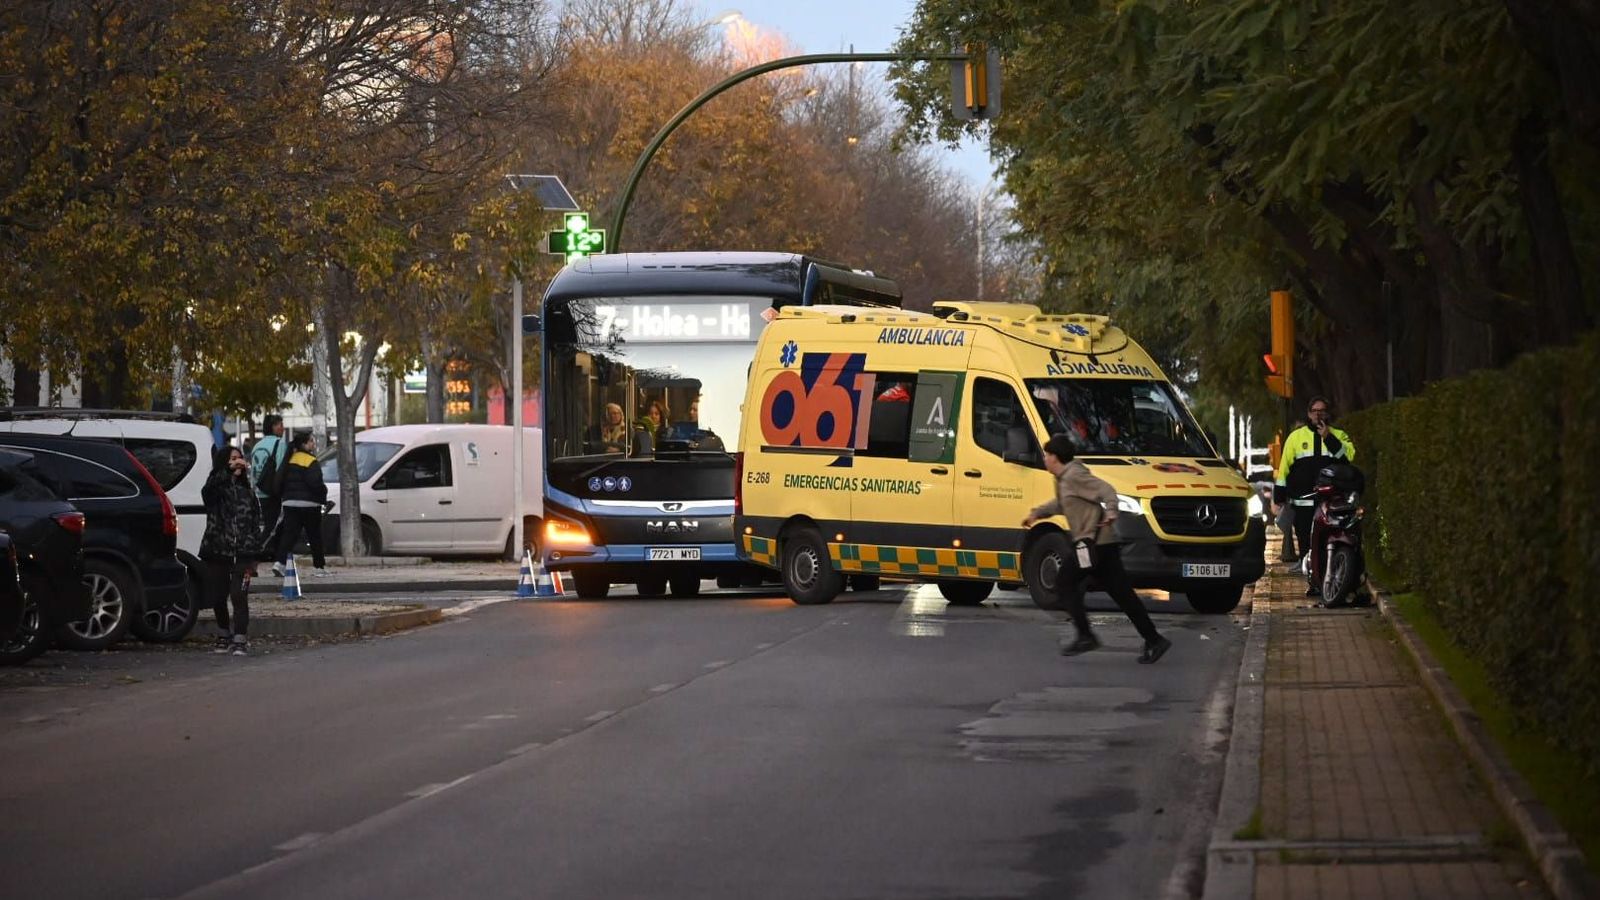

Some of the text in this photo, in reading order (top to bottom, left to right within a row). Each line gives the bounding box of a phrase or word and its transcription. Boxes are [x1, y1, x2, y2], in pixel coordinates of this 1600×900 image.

[632, 305, 698, 336] Holea
[877, 327, 965, 346] AMBULANCIA
[760, 353, 877, 451] 061
[747, 472, 770, 484] E-268
[784, 474, 922, 495] EMERGENCIAS SANITARIAS
[646, 521, 699, 533] MAN
[651, 549, 674, 559] 7721
[1189, 565, 1229, 576] 5106 LVF
